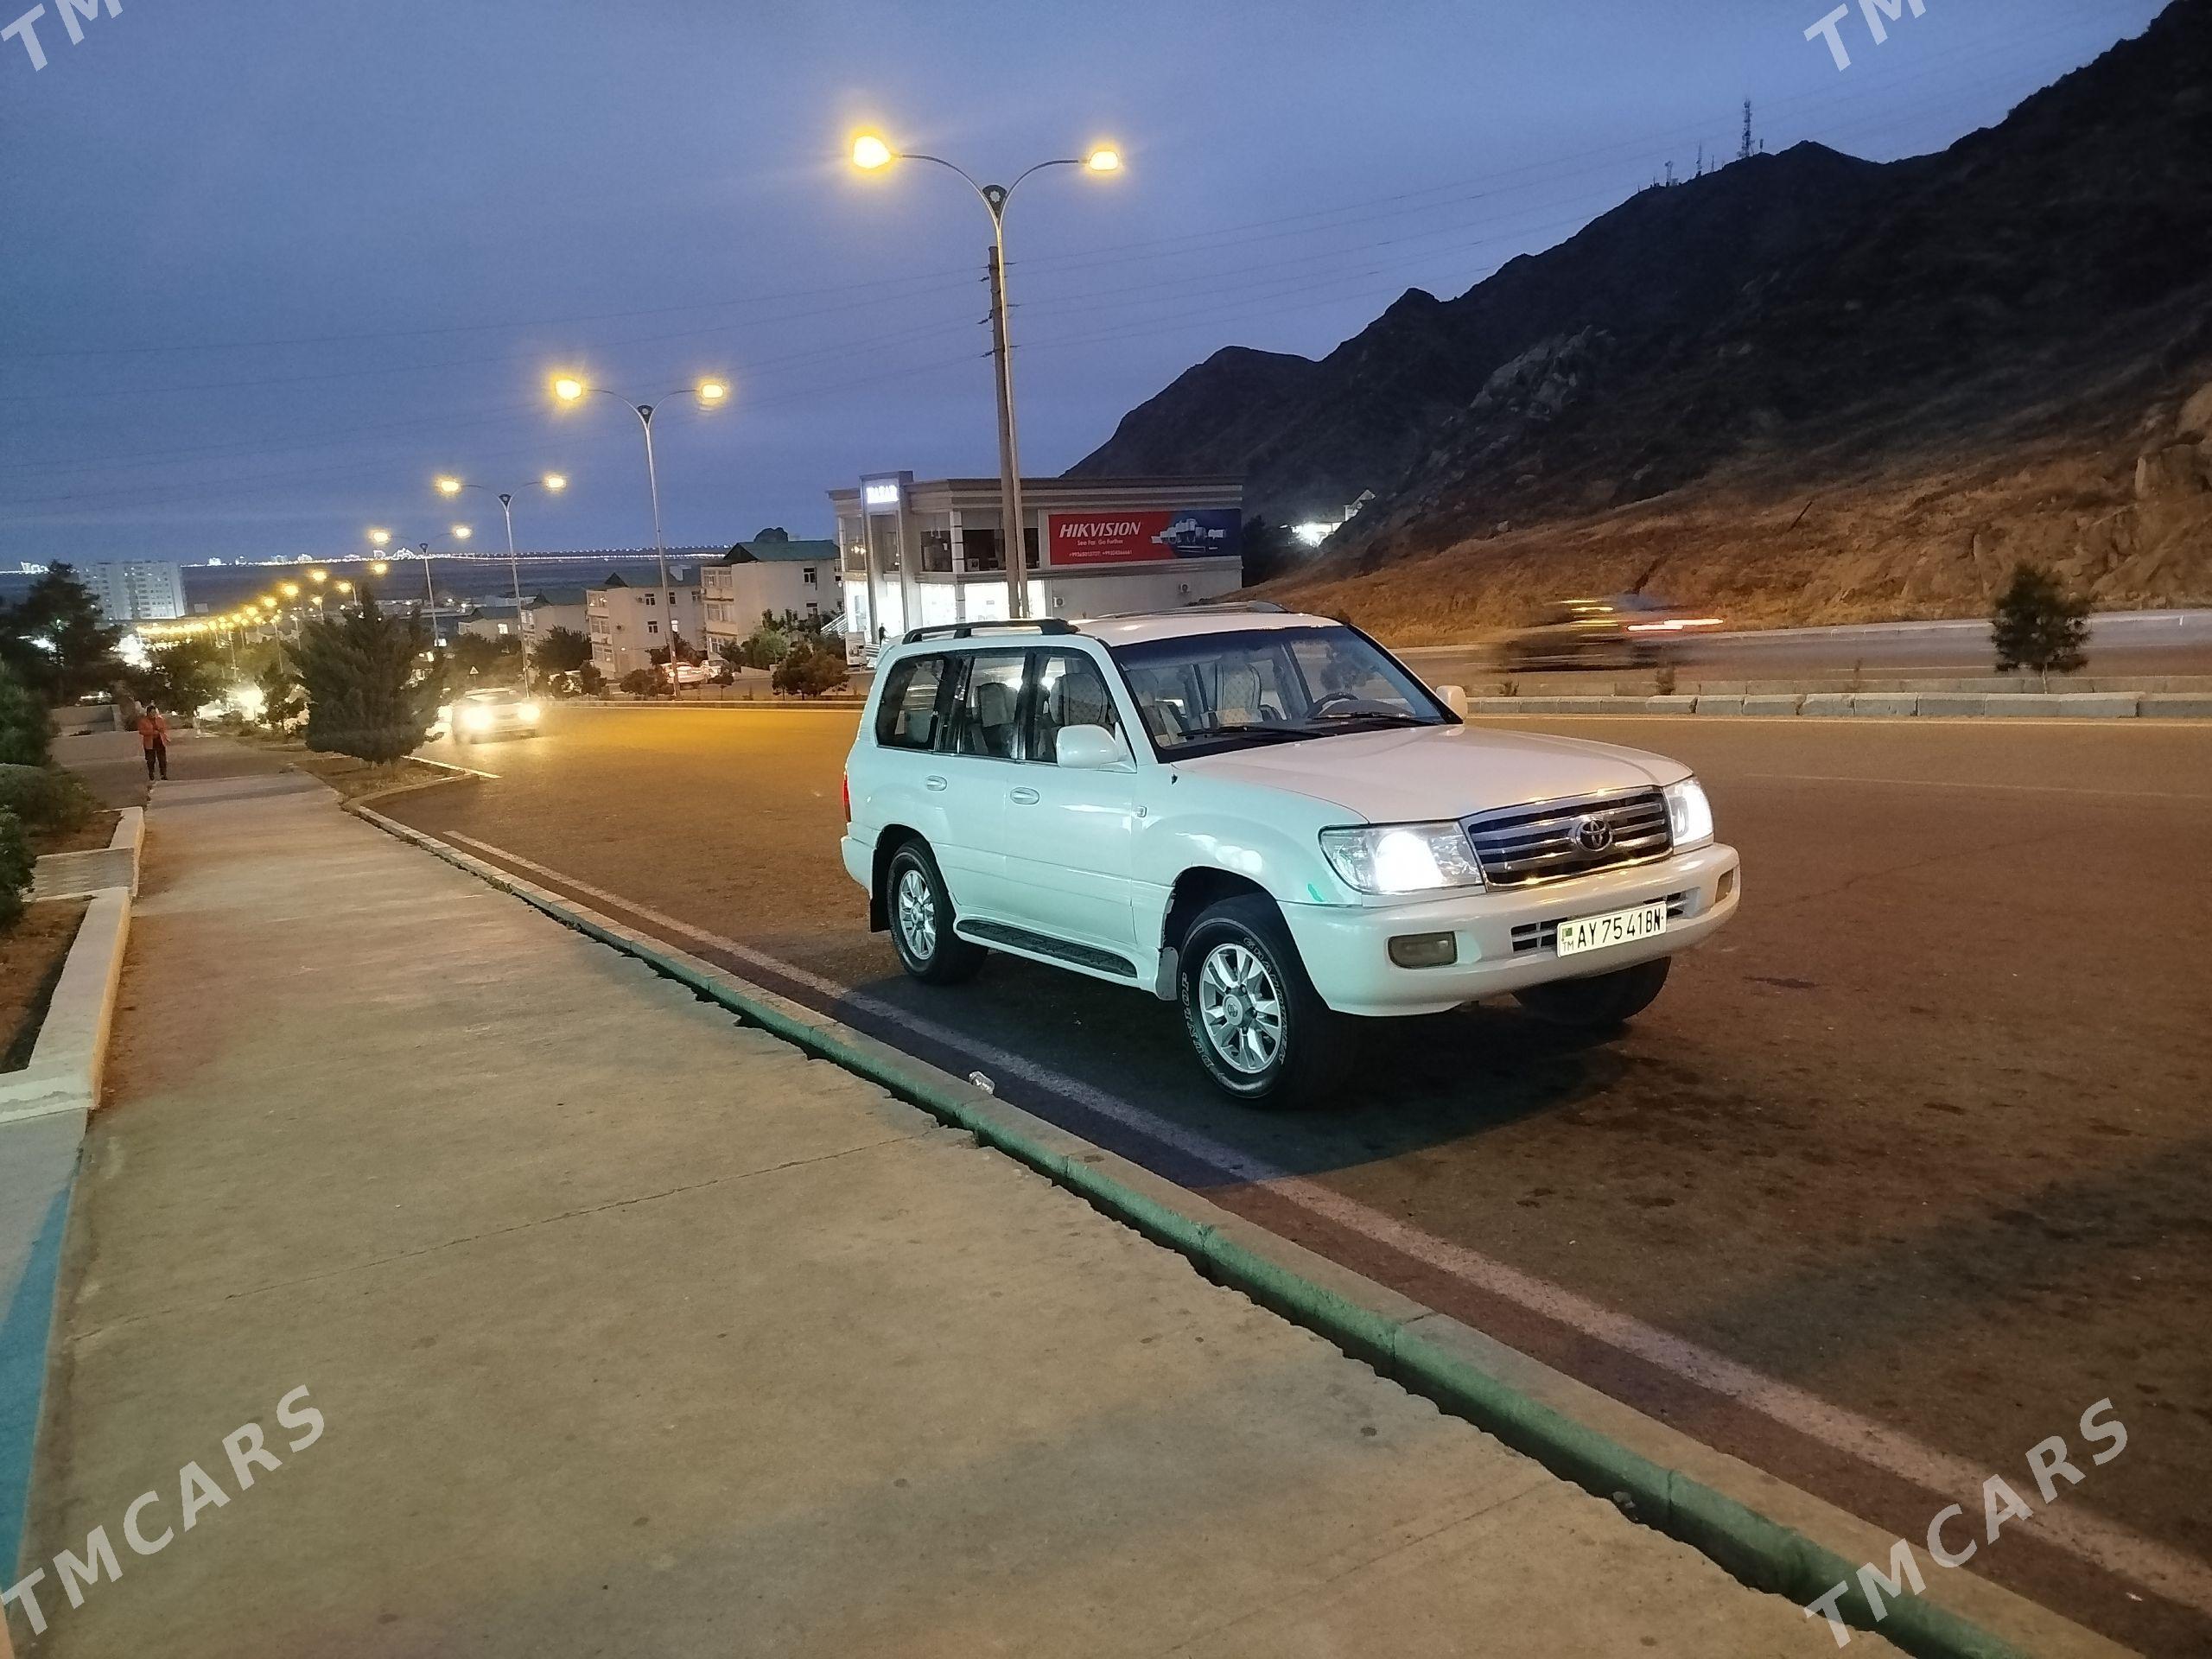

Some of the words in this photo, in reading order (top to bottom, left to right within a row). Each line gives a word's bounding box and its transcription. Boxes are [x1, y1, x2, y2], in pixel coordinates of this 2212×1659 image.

[1059, 522, 1141, 537] HIKVISION
[1561, 940, 1574, 952] TM
[1182, 972, 1214, 1068] DUNLOP
